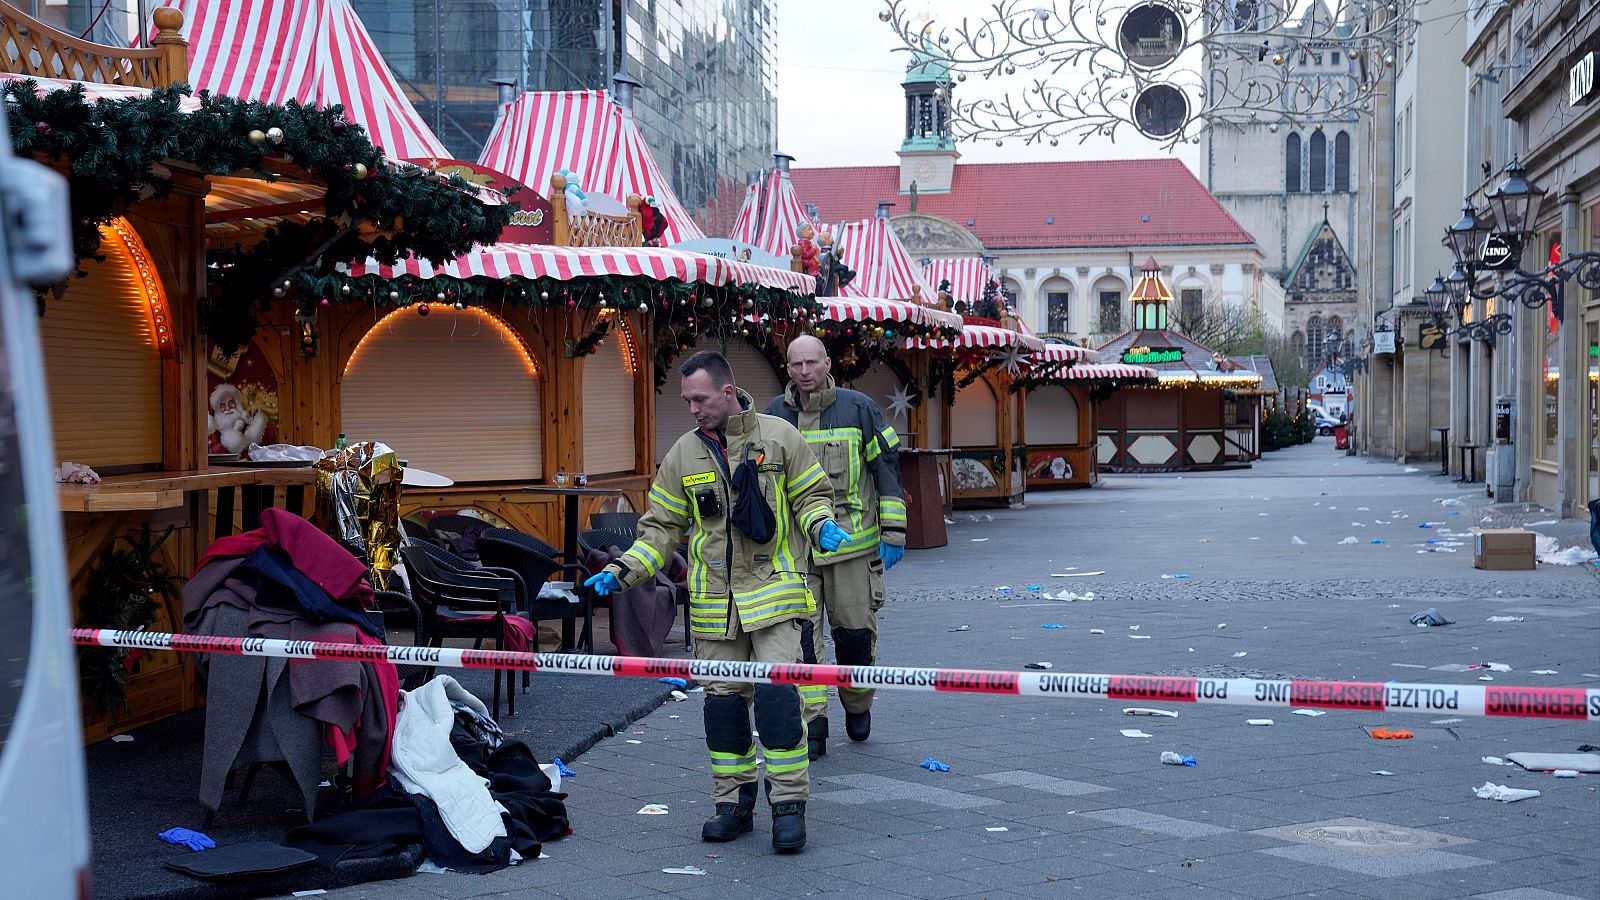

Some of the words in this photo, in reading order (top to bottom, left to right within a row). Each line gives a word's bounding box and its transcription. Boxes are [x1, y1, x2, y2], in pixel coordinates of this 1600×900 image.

[1570, 51, 1594, 107] KIND
[112, 629, 266, 653] POLIZEIABSPERRUNG
[284, 640, 441, 662] POLIZEIABSPERRUNG
[461, 650, 623, 671] POLIZEIABSPERRUNG
[644, 659, 813, 681] POLIZEIABSPERRUNG
[836, 667, 1014, 690] POLIZEIABSPERRUNG
[1039, 674, 1228, 699] POLIZEIABSPERRUNG
[1254, 682, 1458, 710] POLIZEIABSPERRUNG
